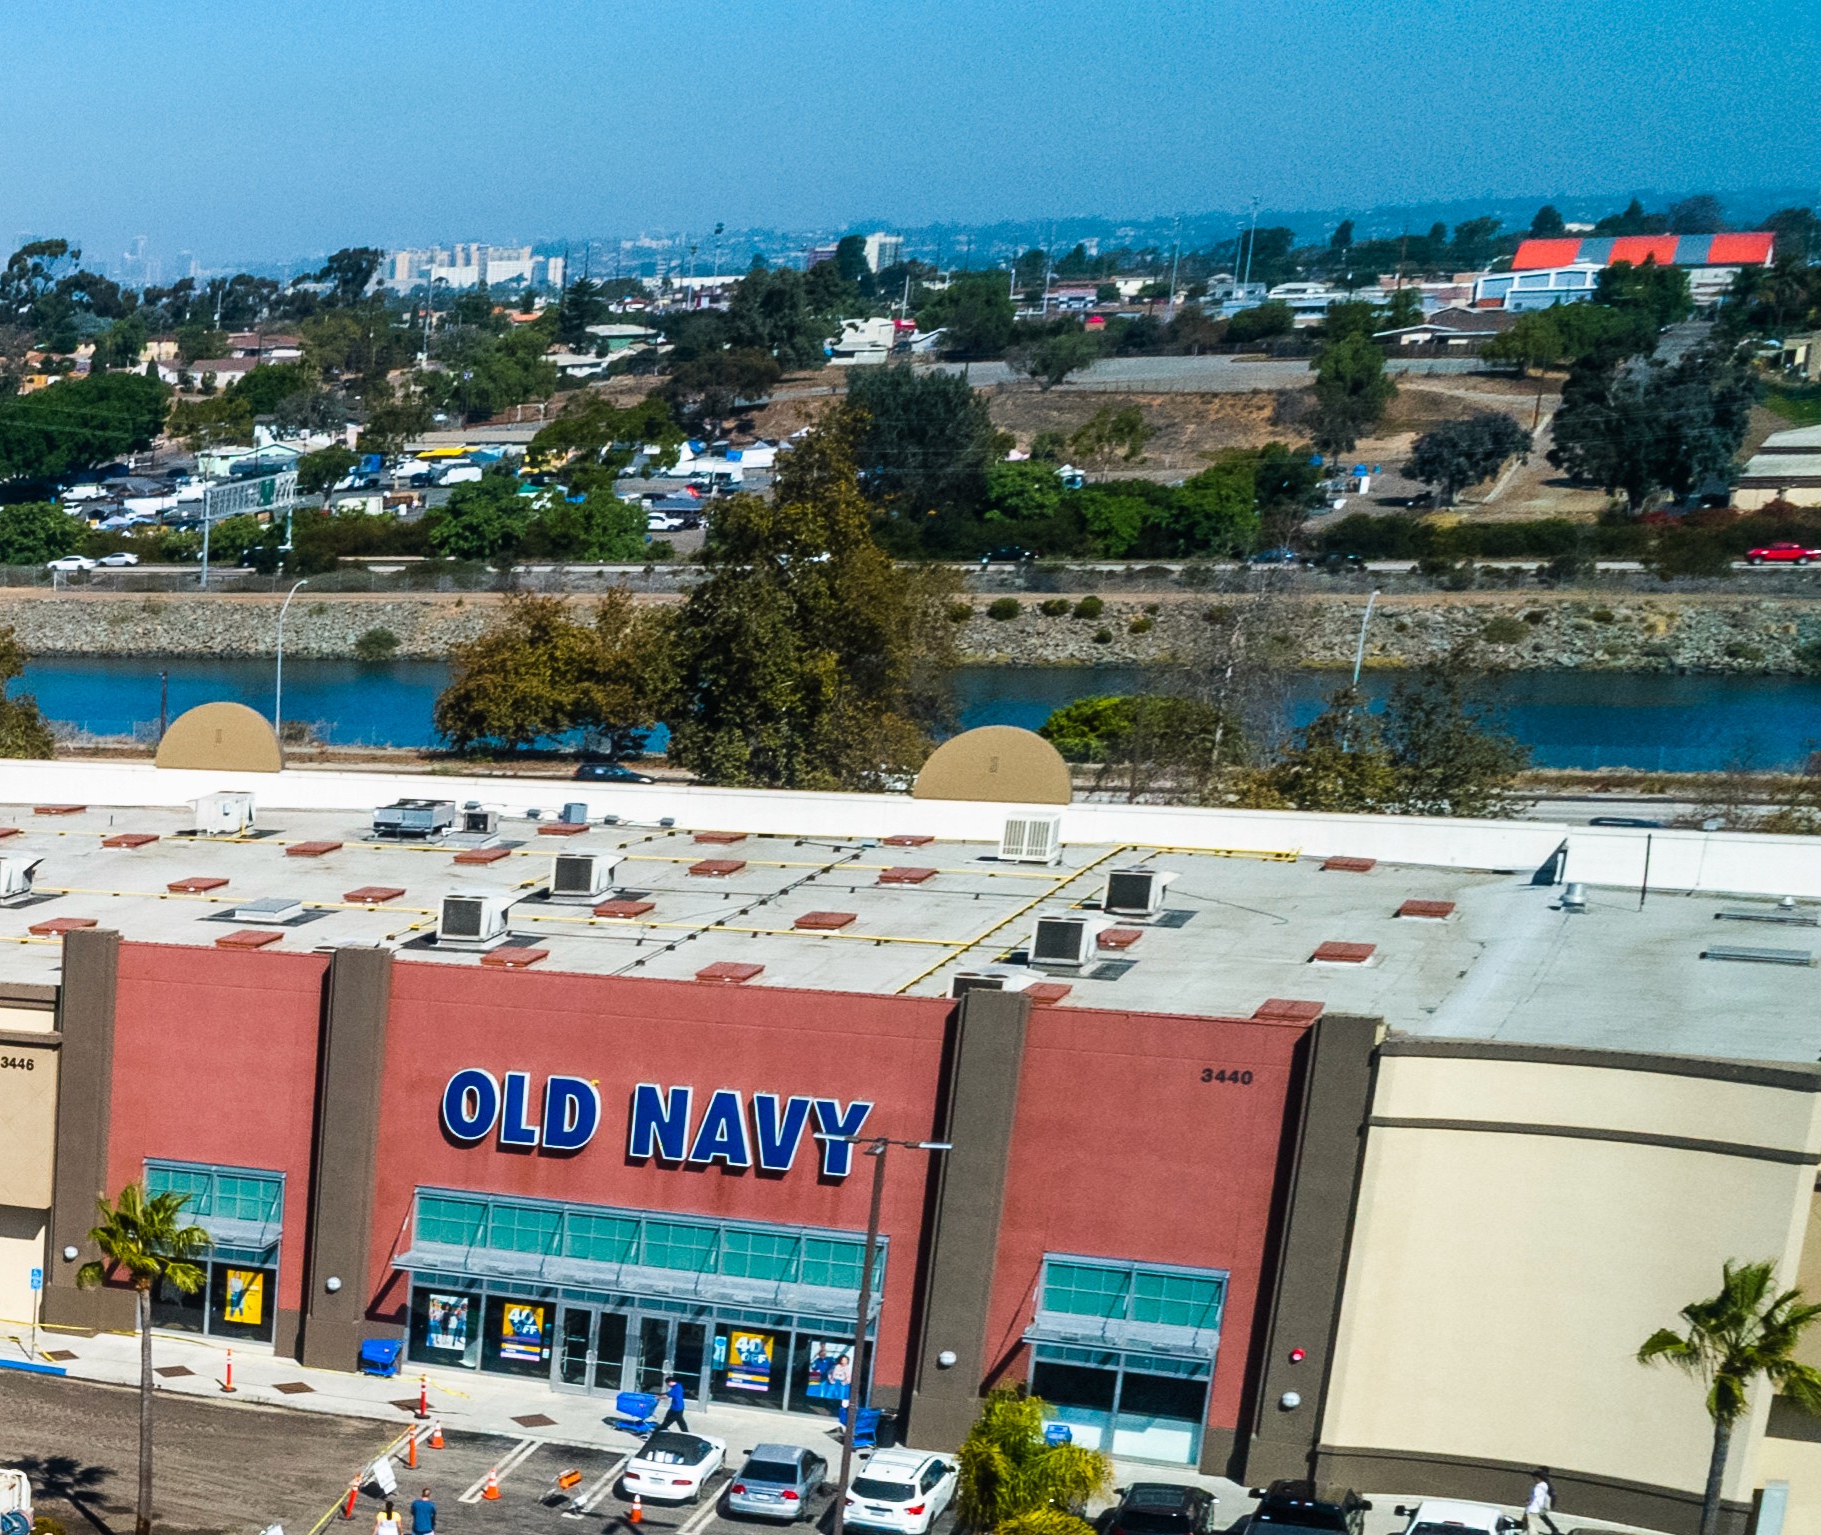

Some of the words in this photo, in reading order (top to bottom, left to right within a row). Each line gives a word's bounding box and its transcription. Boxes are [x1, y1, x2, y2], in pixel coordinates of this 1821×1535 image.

[0, 1056, 35, 1071] 3446
[1200, 1067, 1254, 1086] 3440
[442, 1067, 602, 1151] OLD
[629, 1082, 875, 1177] NAVY
[514, 1323, 538, 1335] OFF
